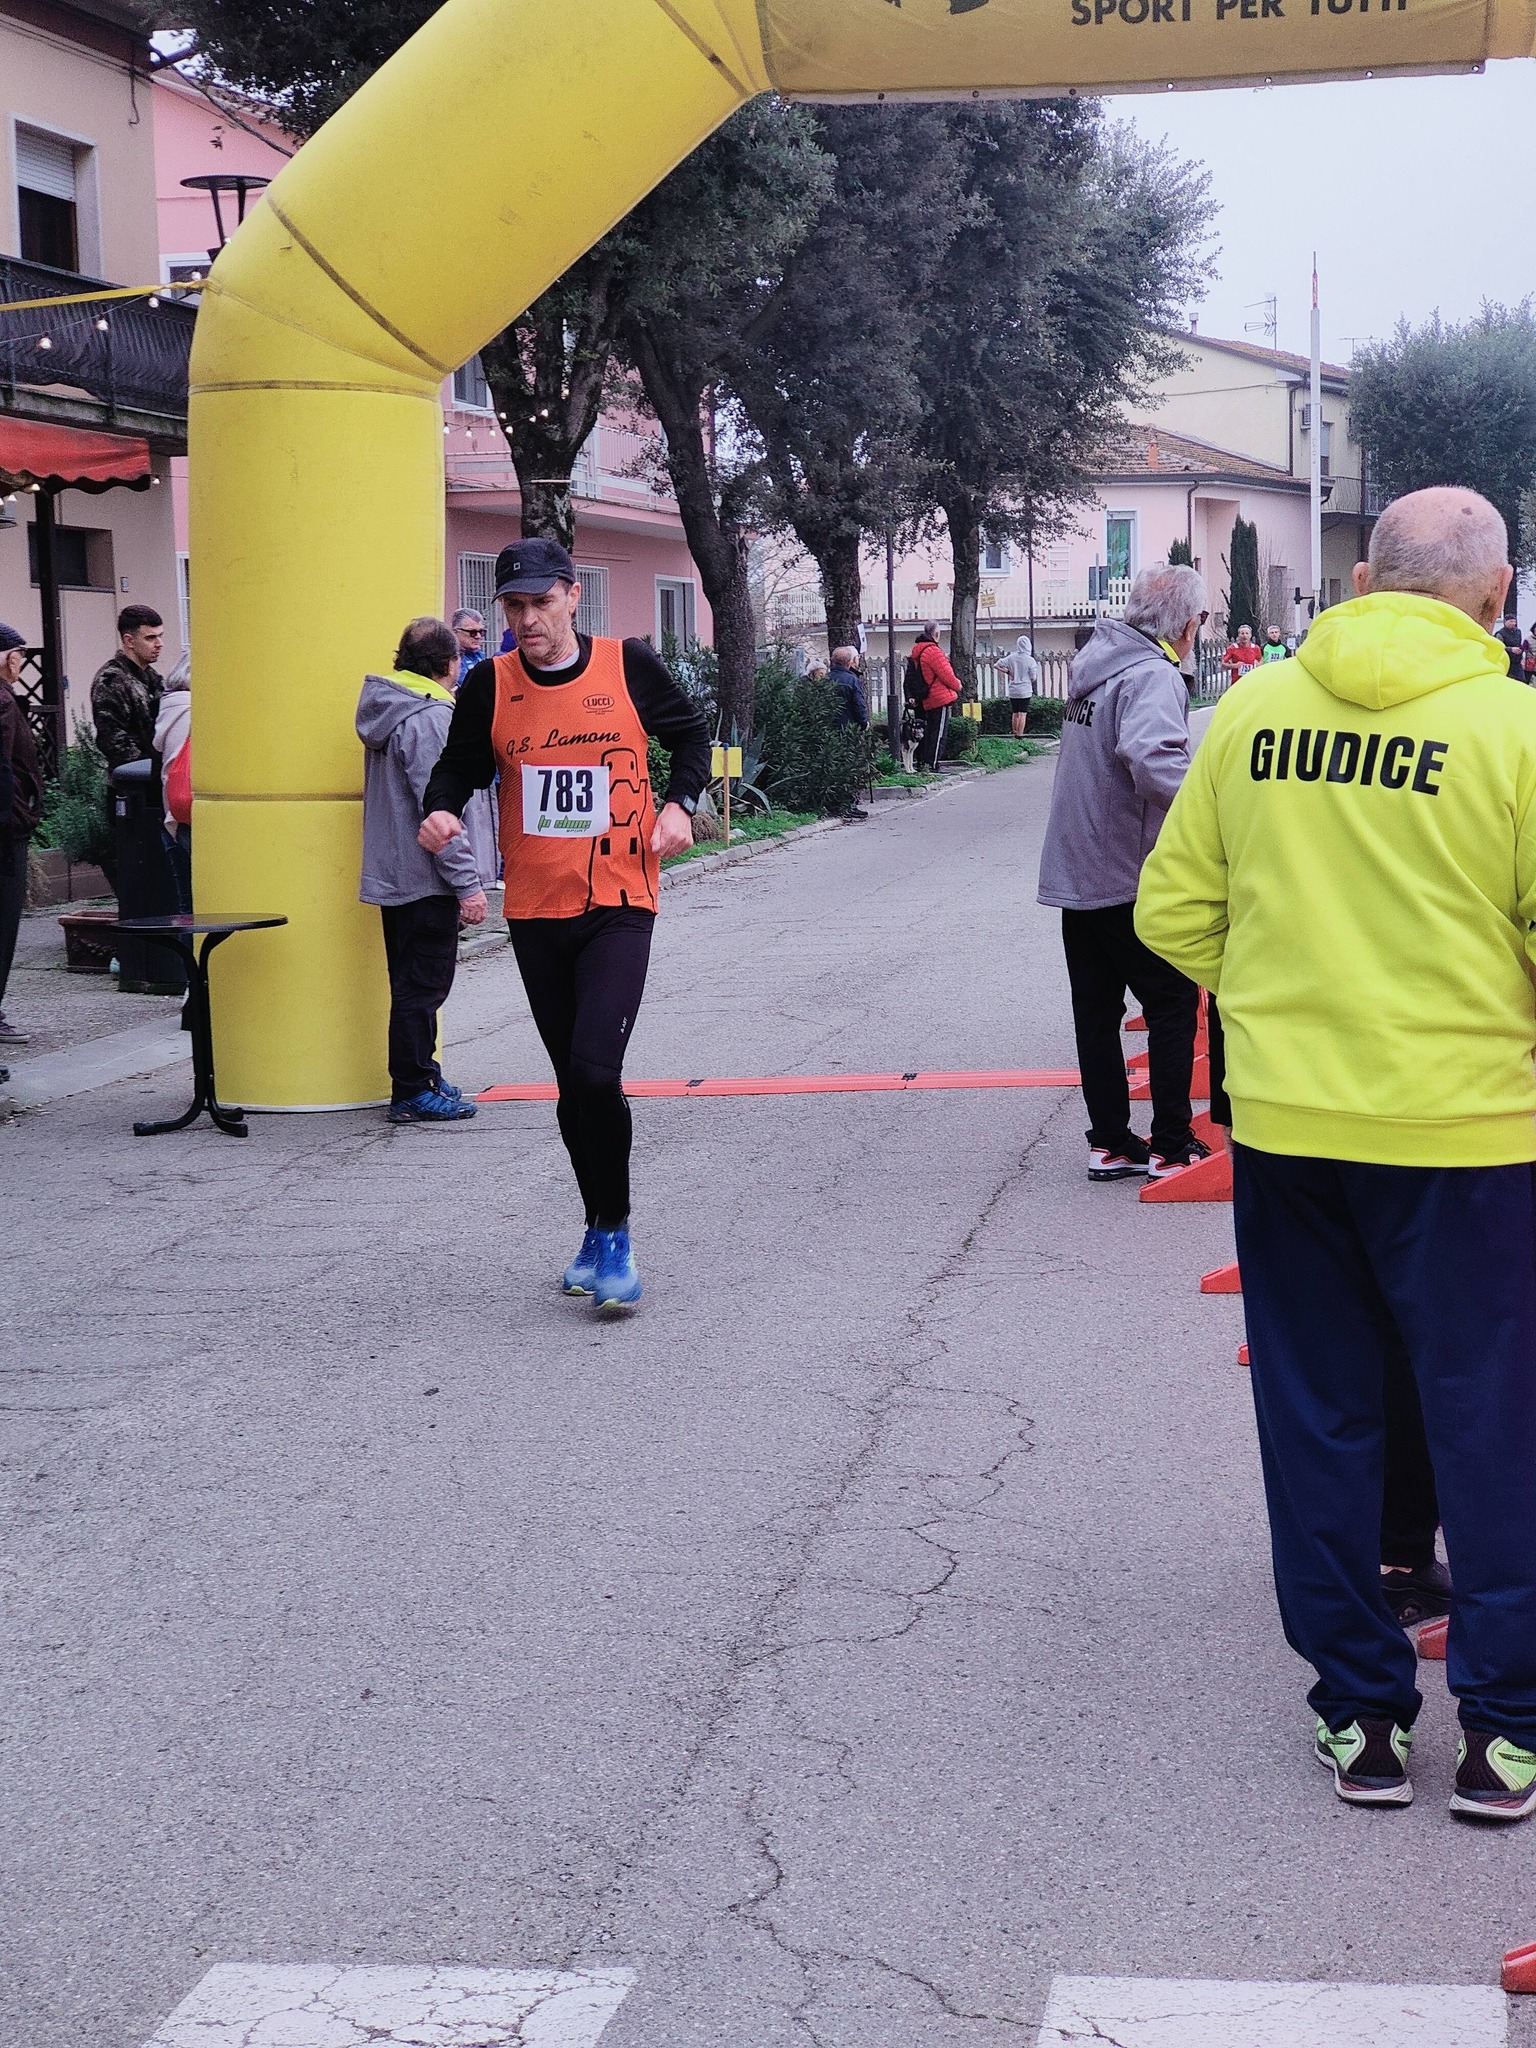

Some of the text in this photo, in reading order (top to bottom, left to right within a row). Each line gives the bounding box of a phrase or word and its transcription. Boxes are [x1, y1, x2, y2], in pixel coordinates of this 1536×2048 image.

[1216, 0, 1285, 20] PER
[587, 697, 611, 706] LUCCI
[506, 728, 621, 759] G.S. Lamone
[1250, 728, 1449, 797] GIUDICE
[537, 769, 593, 812] 783
